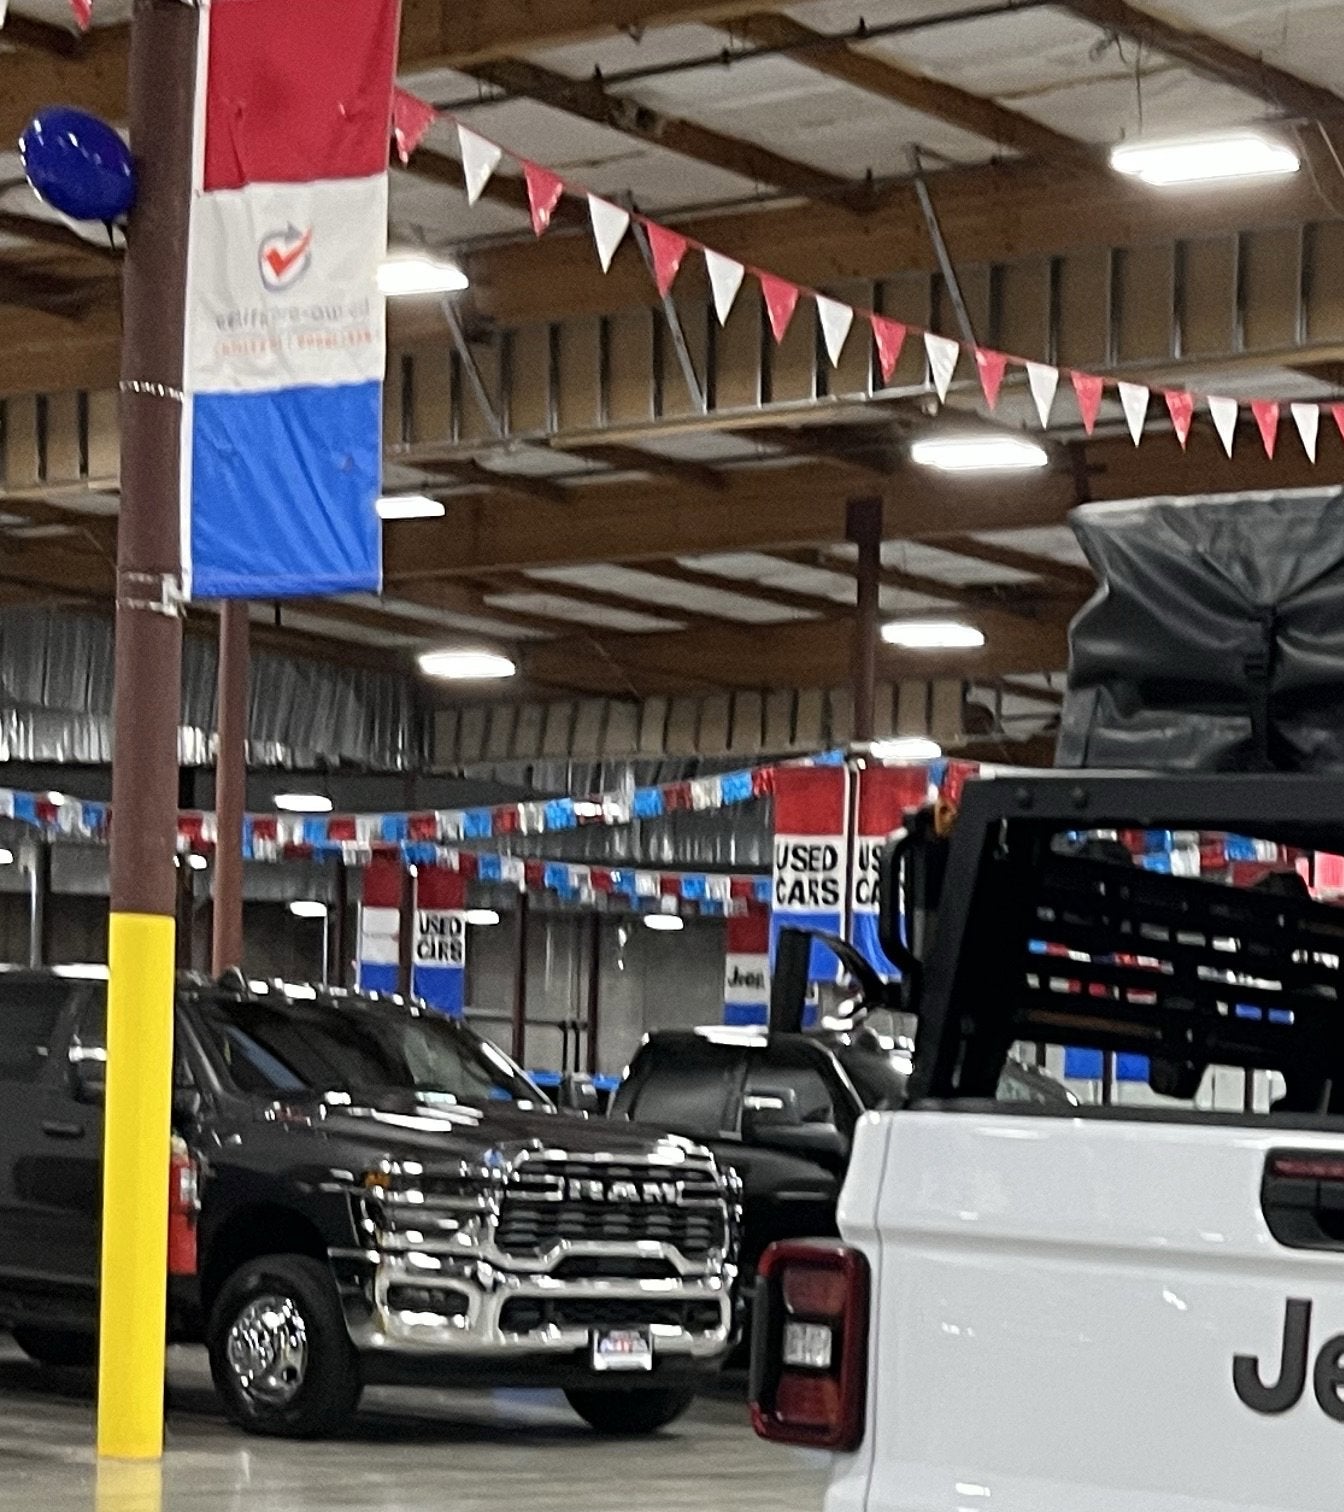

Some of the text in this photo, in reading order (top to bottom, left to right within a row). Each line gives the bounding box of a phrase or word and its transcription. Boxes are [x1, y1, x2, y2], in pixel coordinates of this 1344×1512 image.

[776, 843, 839, 873] USED
[859, 843, 882, 872] US
[776, 878, 840, 906] CARS
[855, 878, 881, 905] CA
[420, 914, 462, 936] USED
[727, 965, 765, 990] Jeep
[568, 1178, 677, 1203] RAM
